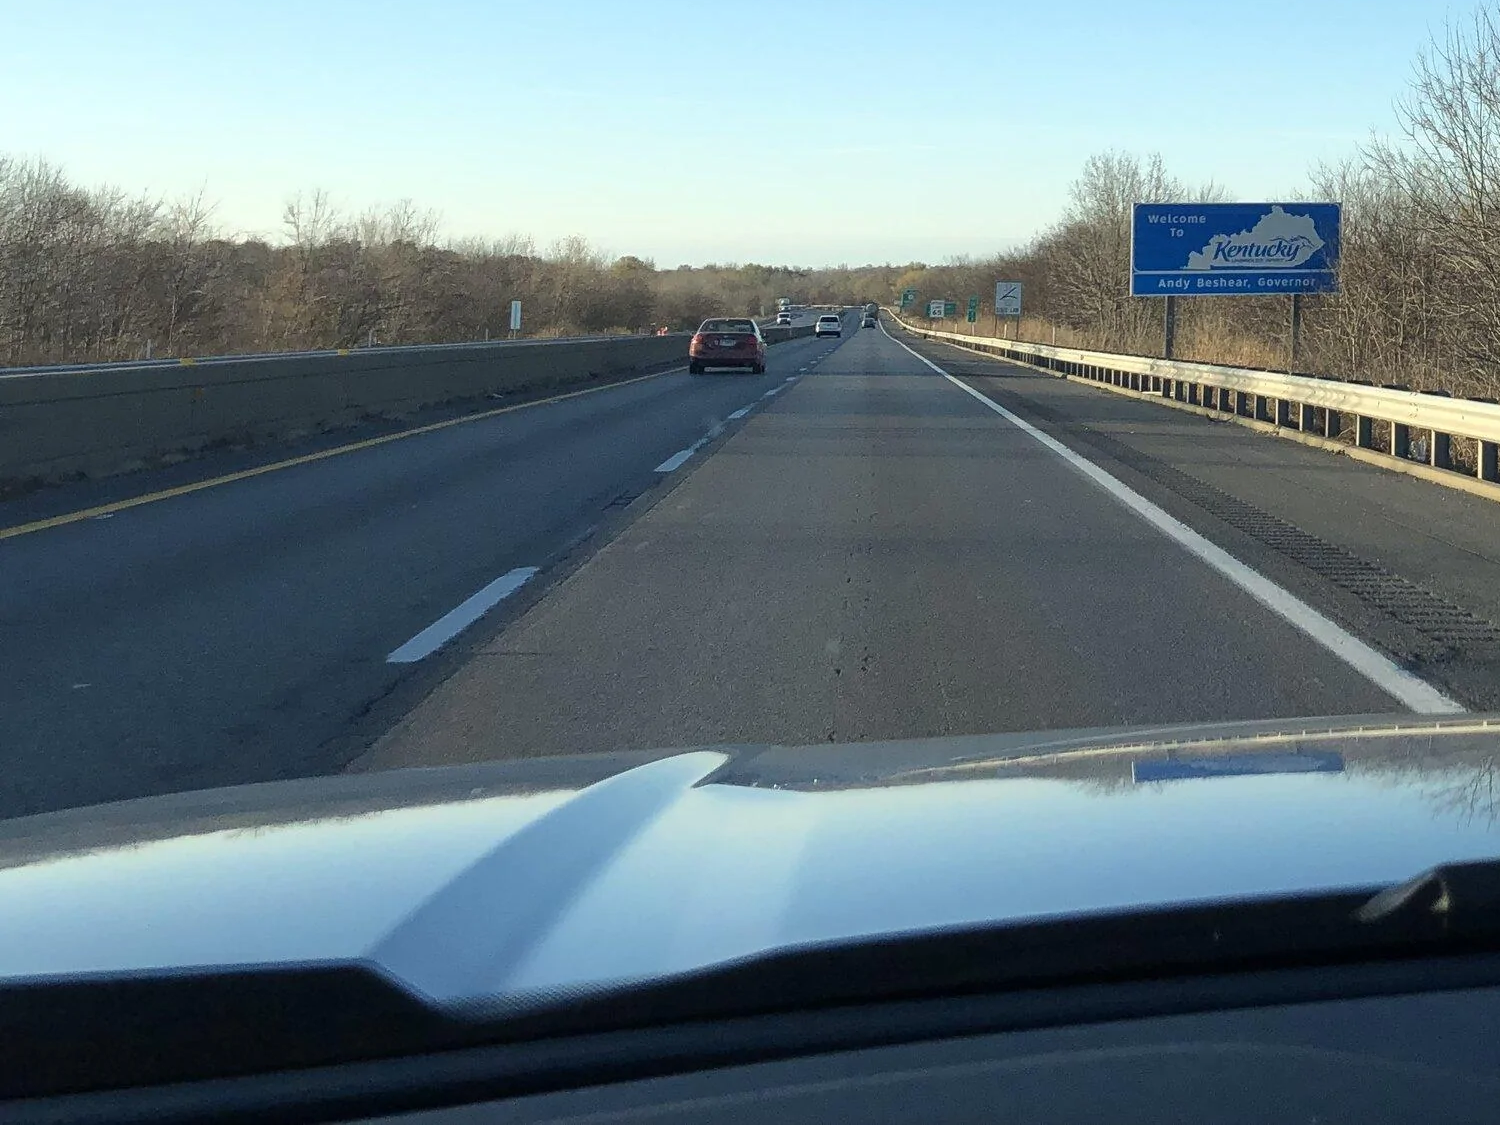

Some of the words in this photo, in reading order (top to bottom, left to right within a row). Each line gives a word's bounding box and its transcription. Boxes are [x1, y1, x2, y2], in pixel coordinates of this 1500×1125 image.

[1148, 213, 1207, 224] Welcome
[1169, 227, 1185, 238] To
[1212, 239, 1301, 262] Kentucky
[1158, 278, 1191, 289] Andy
[1196, 277, 1251, 288] Beshear,
[1257, 277, 1316, 288] Governor
